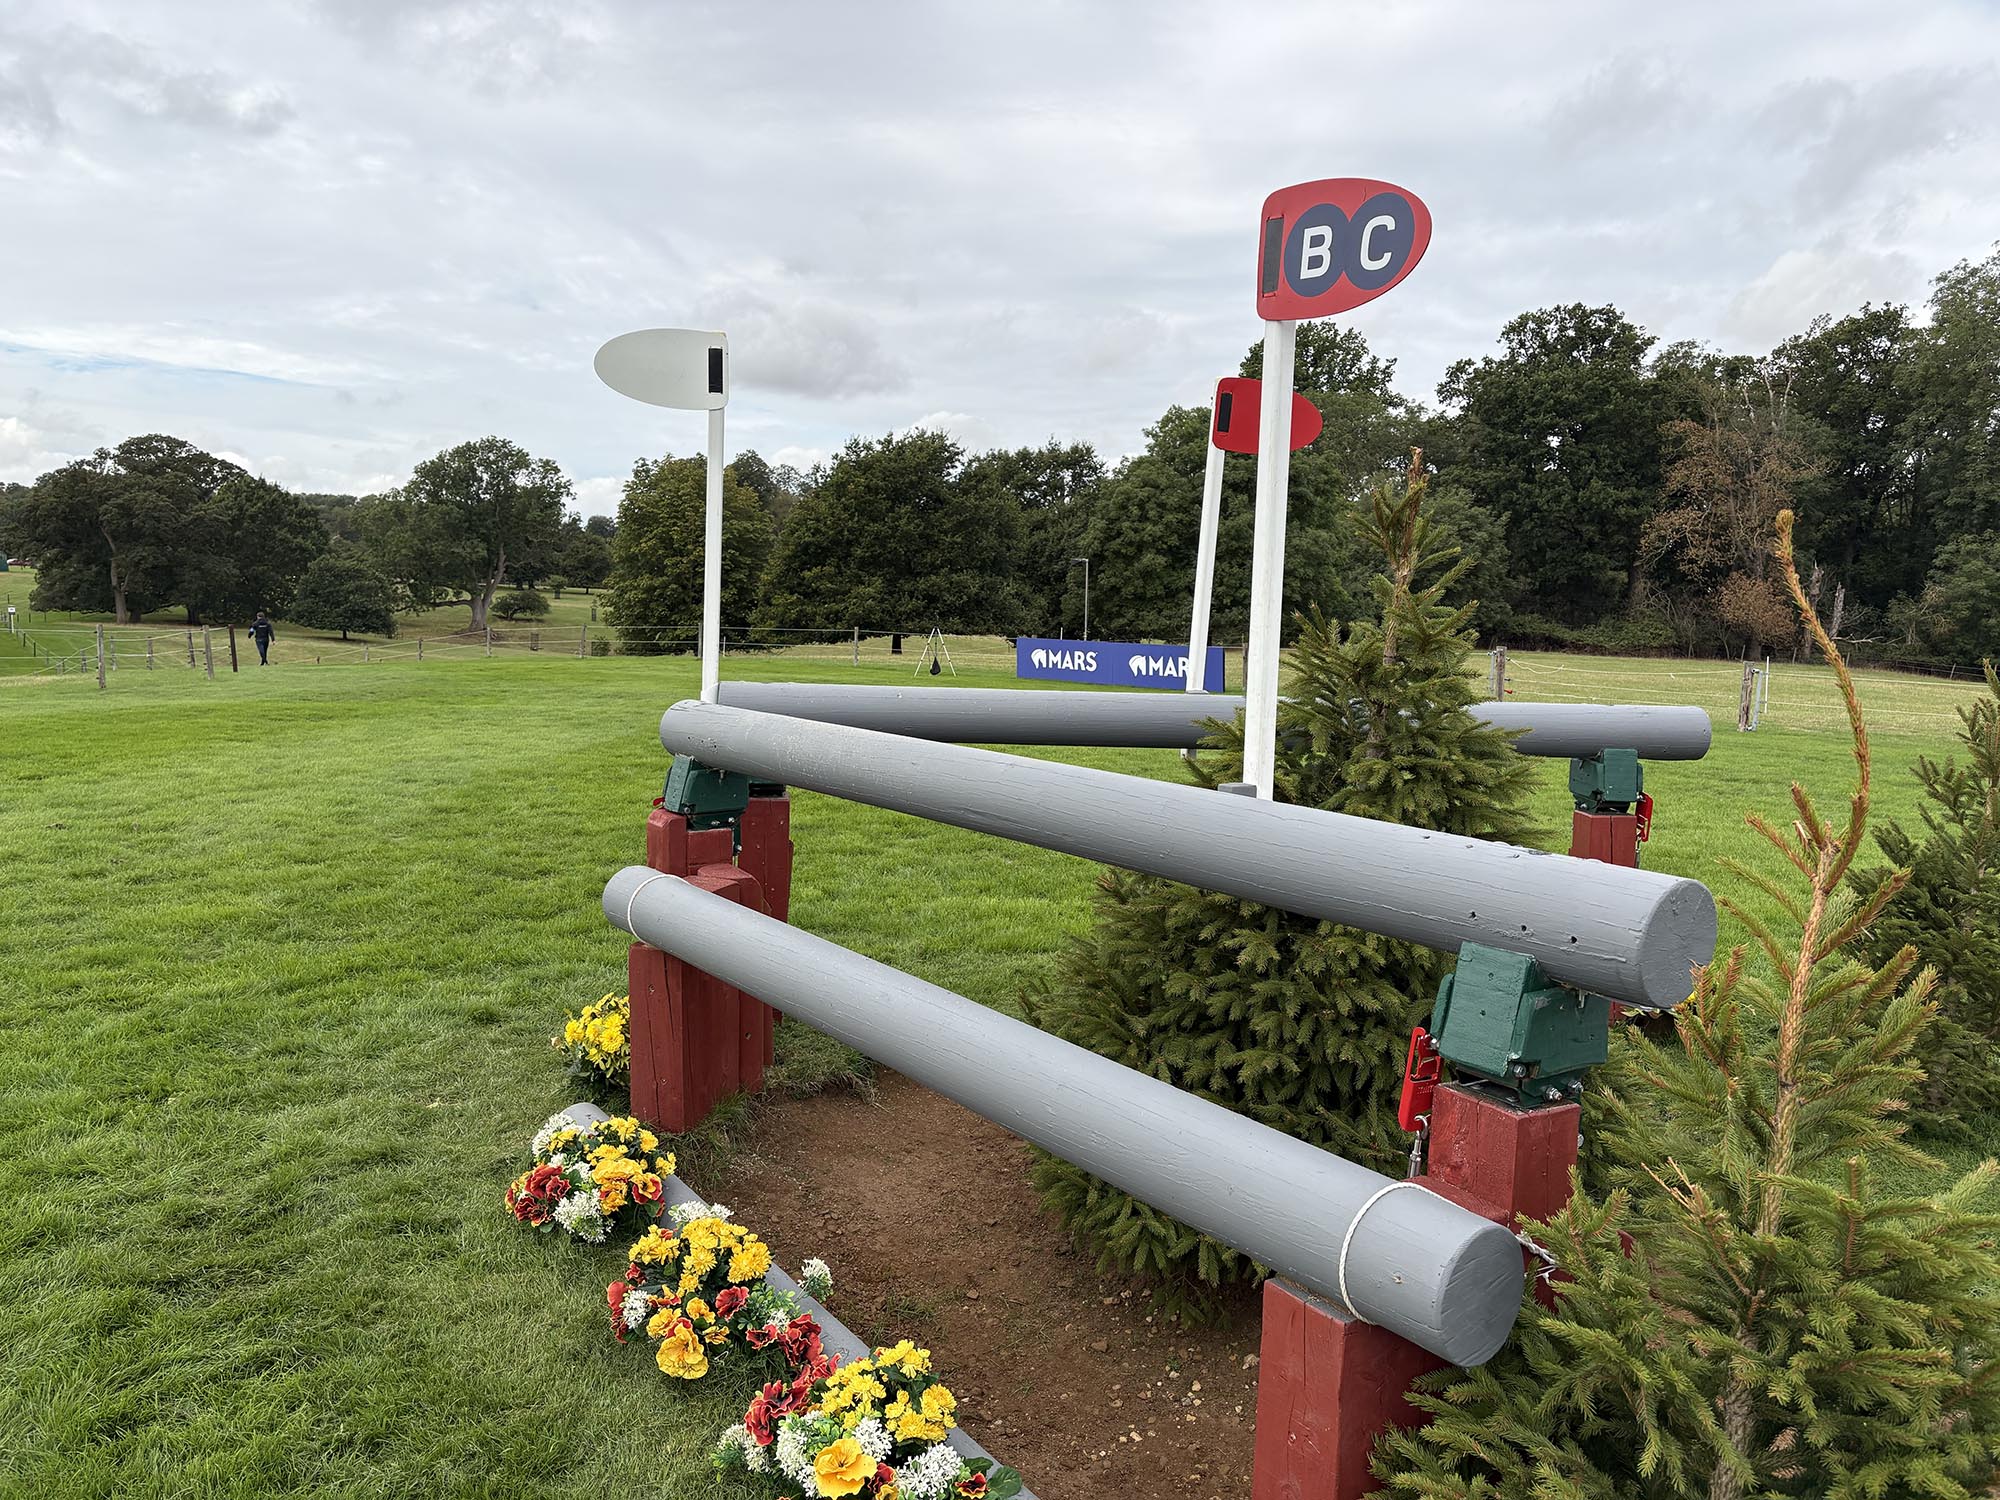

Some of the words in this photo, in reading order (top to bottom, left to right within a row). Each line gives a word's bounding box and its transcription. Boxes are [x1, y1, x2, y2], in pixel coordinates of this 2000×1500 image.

[1300, 225, 1333, 280] B
[1359, 214, 1396, 271] C
[1048, 649, 1098, 672] MARS
[1148, 655, 1190, 678] MAR
